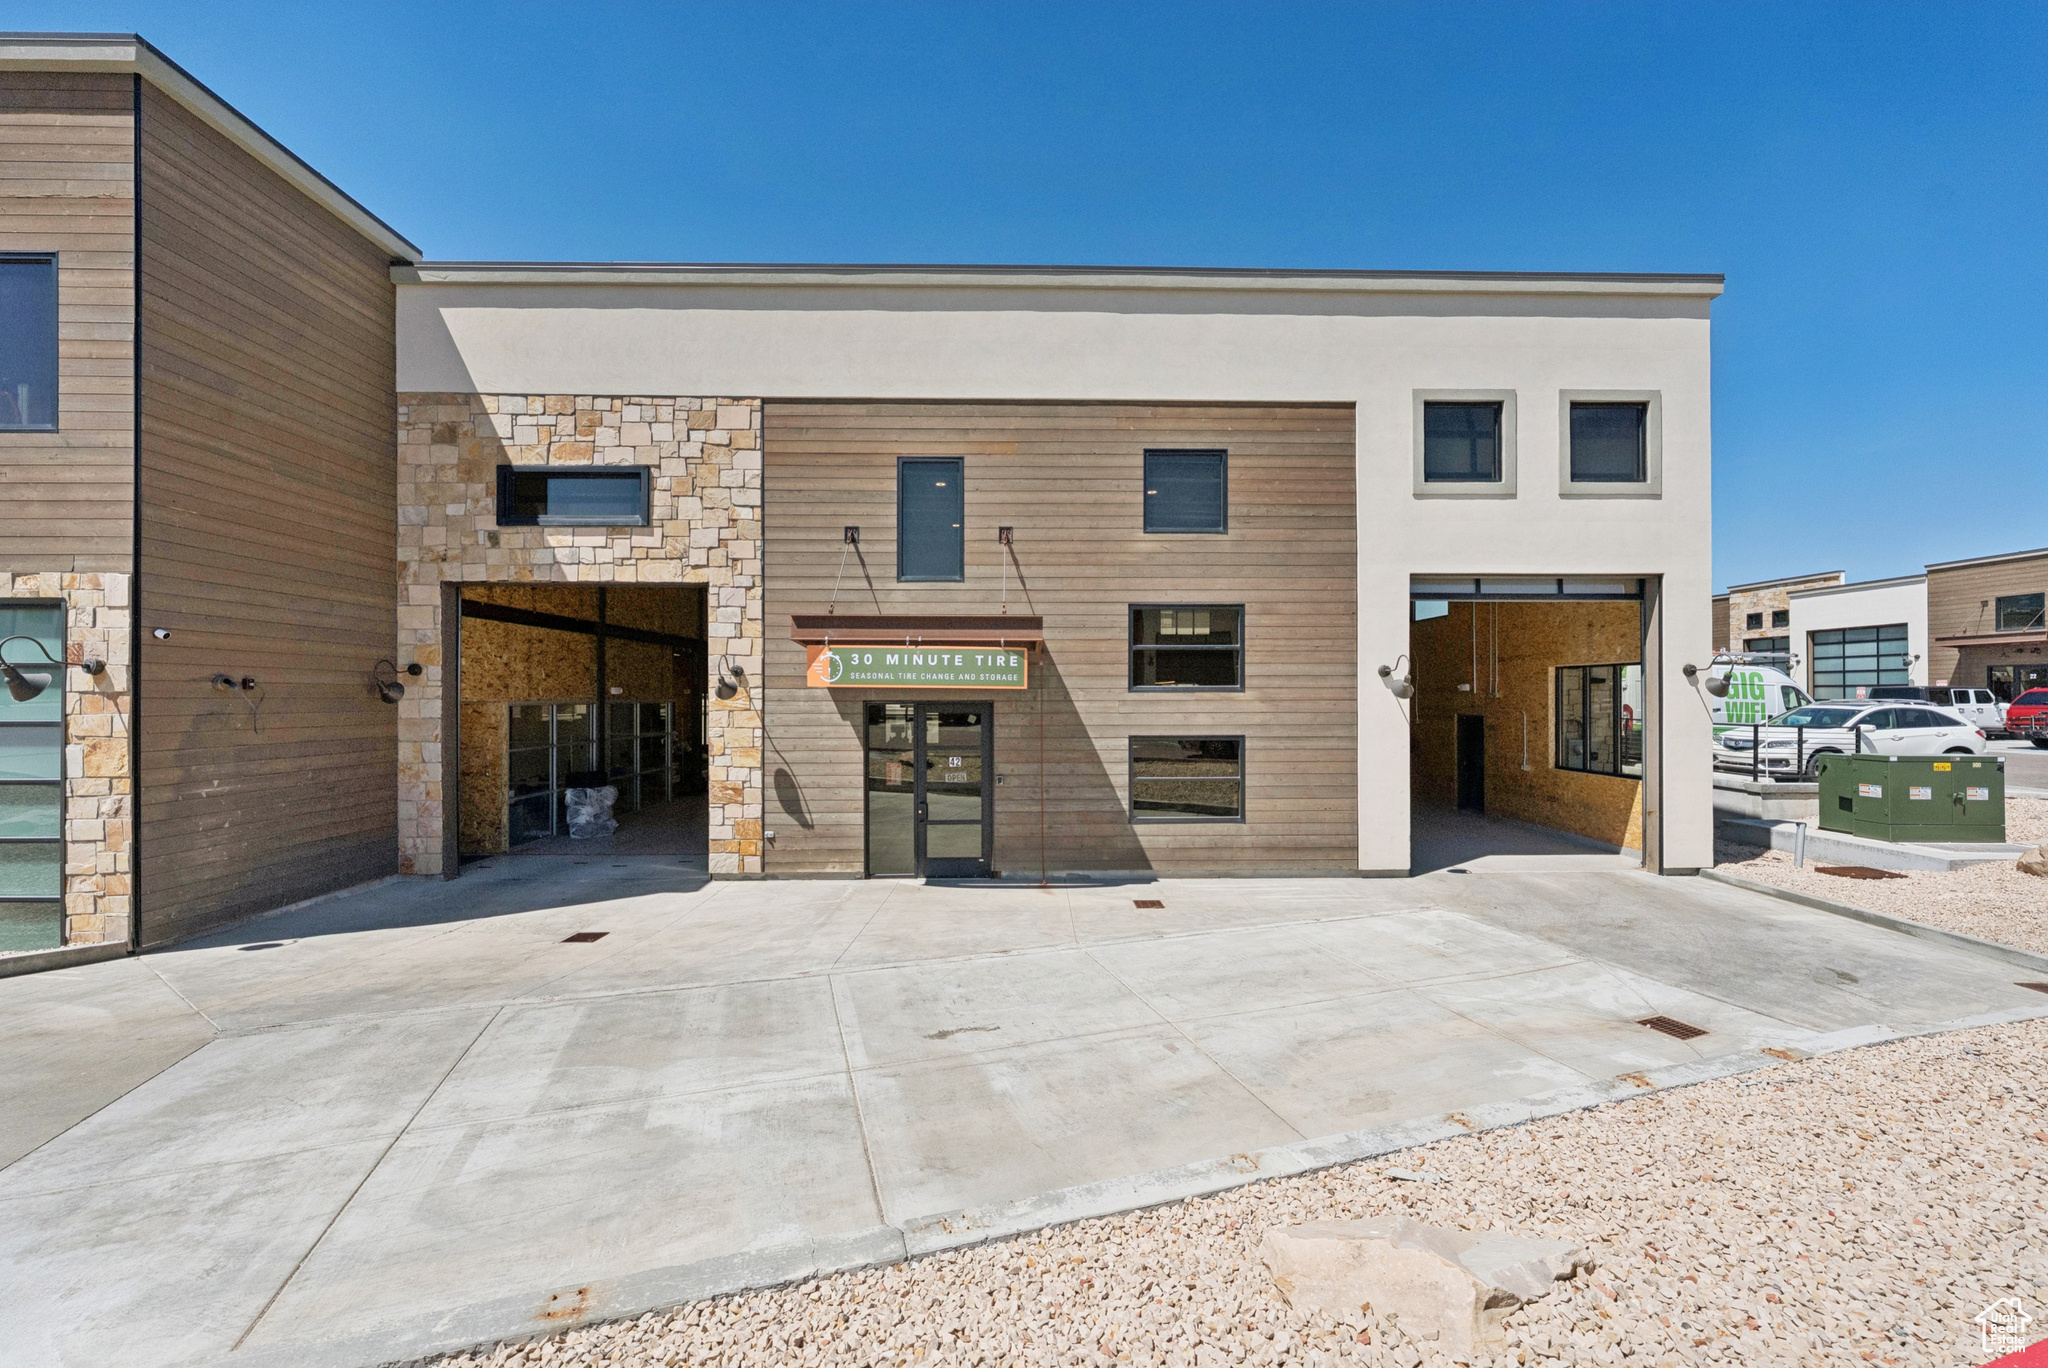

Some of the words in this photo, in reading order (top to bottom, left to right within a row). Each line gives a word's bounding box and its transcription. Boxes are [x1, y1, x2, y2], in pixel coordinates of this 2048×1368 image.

[850, 653, 873, 665] 30
[886, 654, 963, 666] MINUTE
[975, 655, 1018, 667] TIRE
[850, 672, 895, 680] SEASONAL
[898, 672, 917, 680] TIRE
[920, 672, 955, 681] CHANGE
[958, 673, 976, 681] AND
[979, 673, 1018, 681] STORAGE
[1724, 671, 1766, 700] GIG
[1725, 701, 1766, 723] WIFI
[950, 757, 961, 767] 42
[946, 773, 966, 782] OPEN
